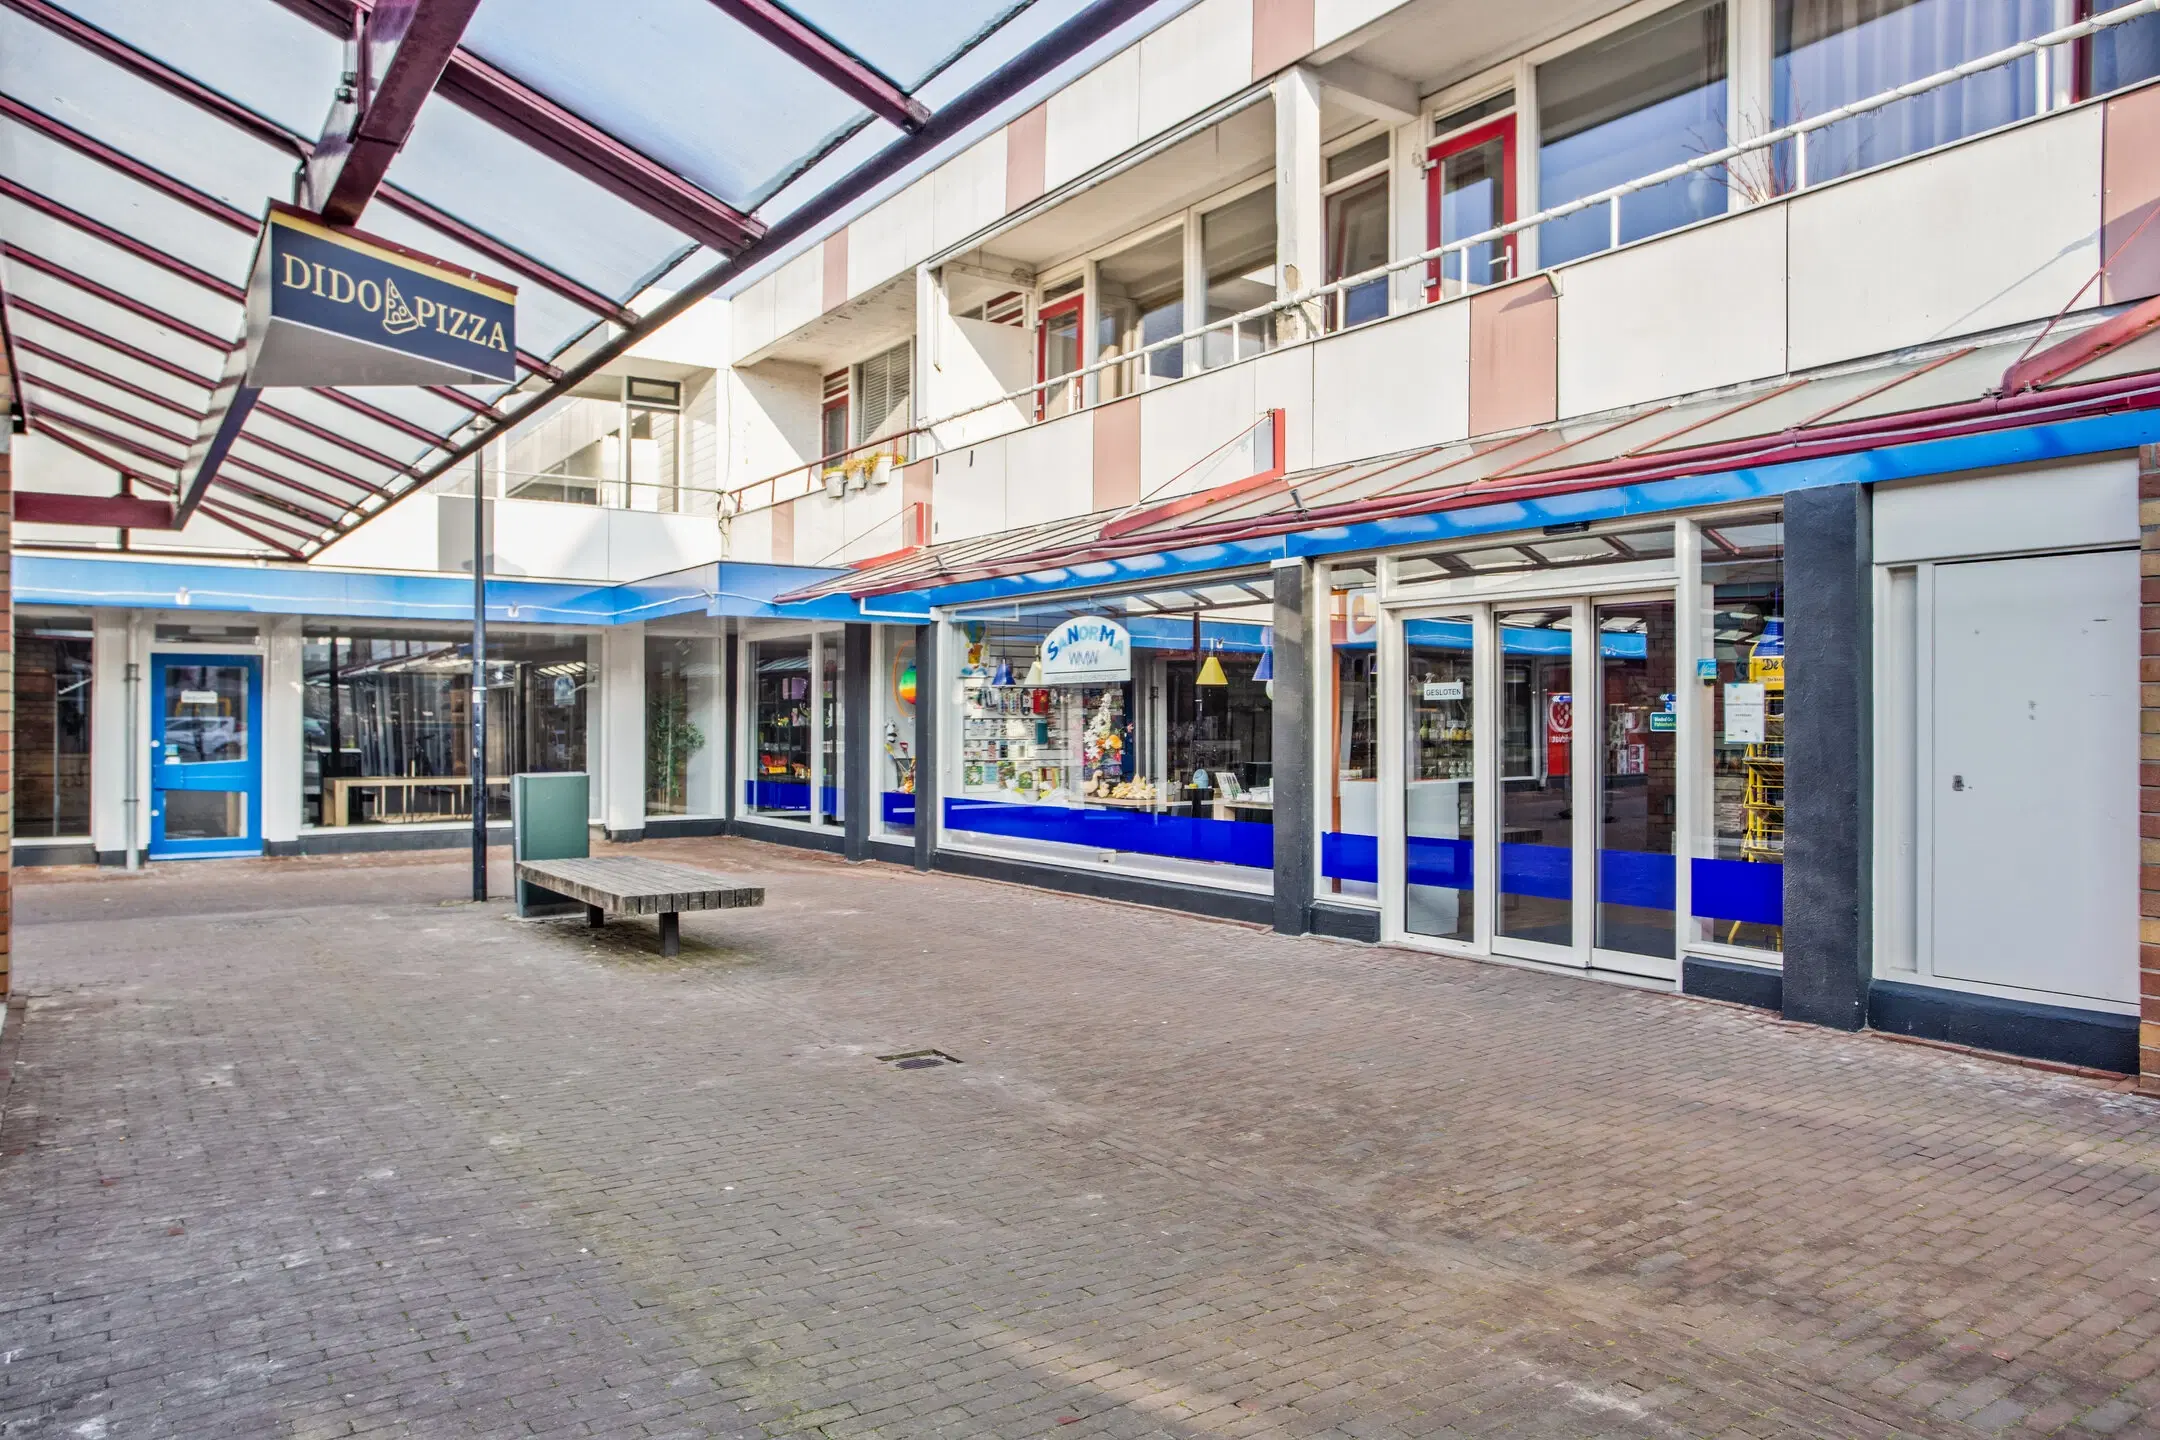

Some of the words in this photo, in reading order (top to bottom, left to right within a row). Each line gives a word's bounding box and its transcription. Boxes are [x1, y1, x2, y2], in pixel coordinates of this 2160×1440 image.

[282, 252, 382, 313] DIDO
[414, 295, 509, 352] PIZZA
[1426, 688, 1461, 697] GESLOTEN
